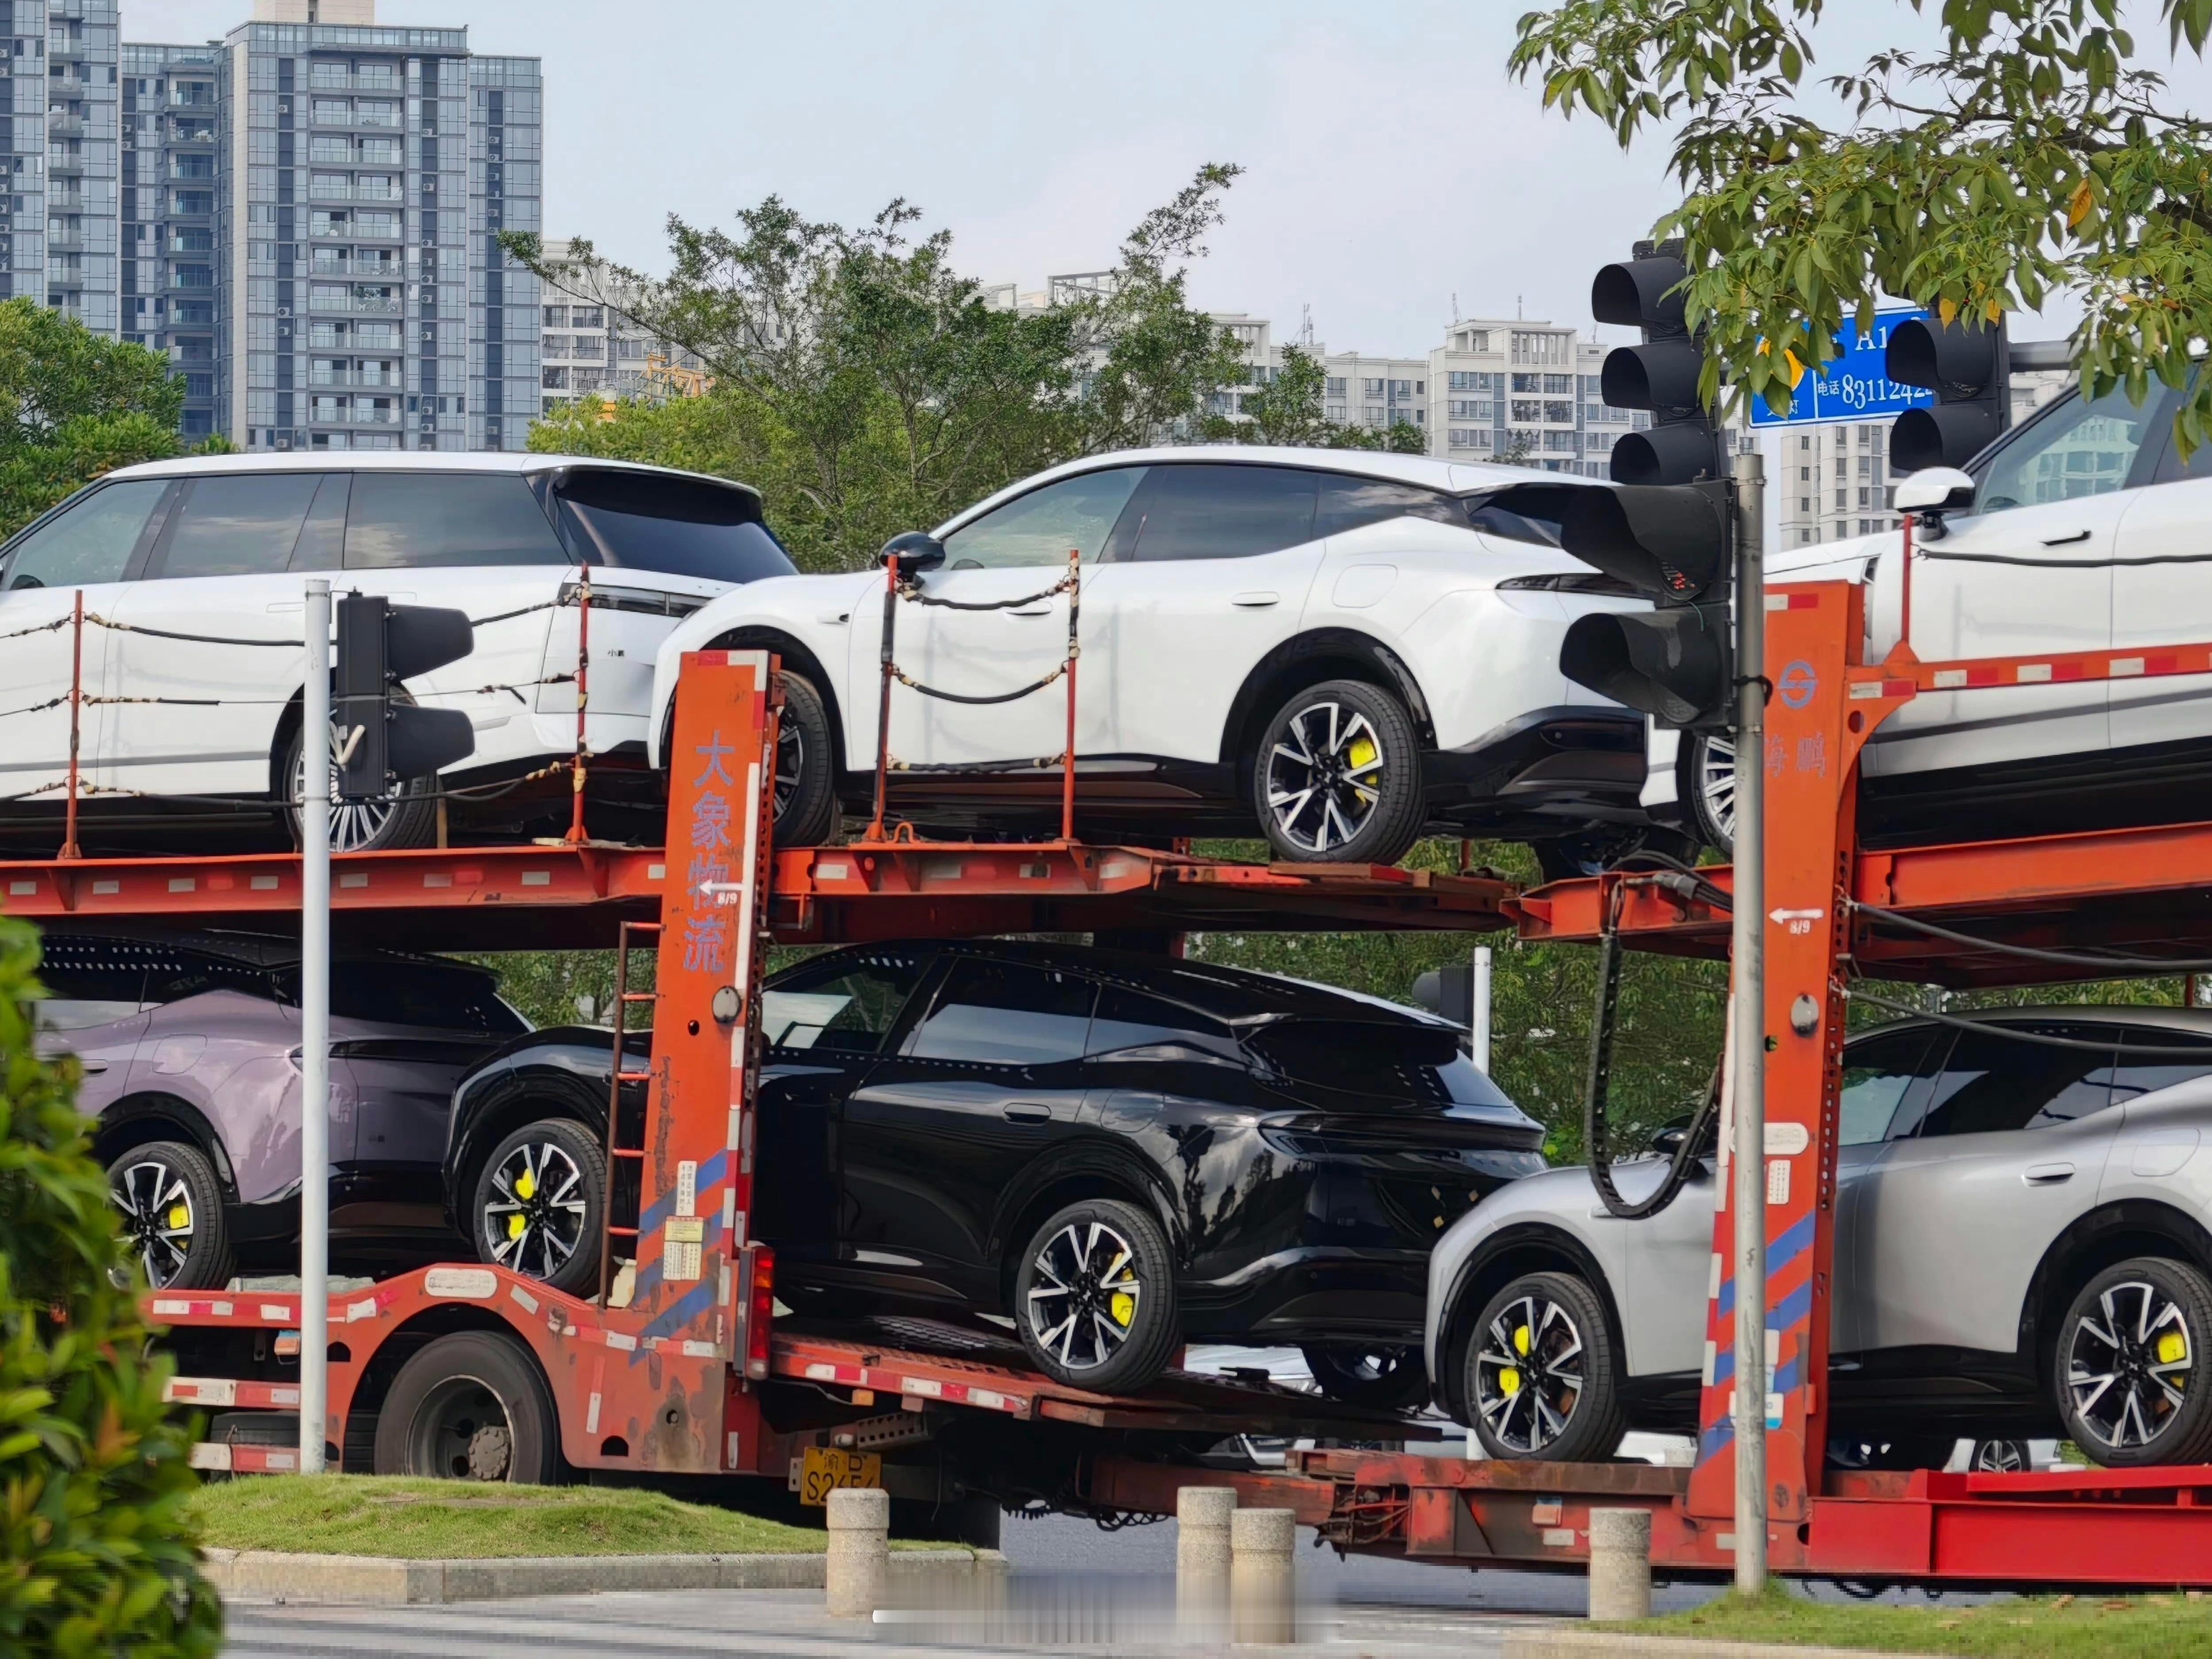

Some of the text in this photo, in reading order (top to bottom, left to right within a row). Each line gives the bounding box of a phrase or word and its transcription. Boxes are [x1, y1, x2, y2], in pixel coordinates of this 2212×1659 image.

[1817, 380, 1839, 396] 电话
[683, 729, 735, 973] 大象物流
[718, 892, 737, 905] 8/9
[1789, 920, 1811, 934] 8/9
